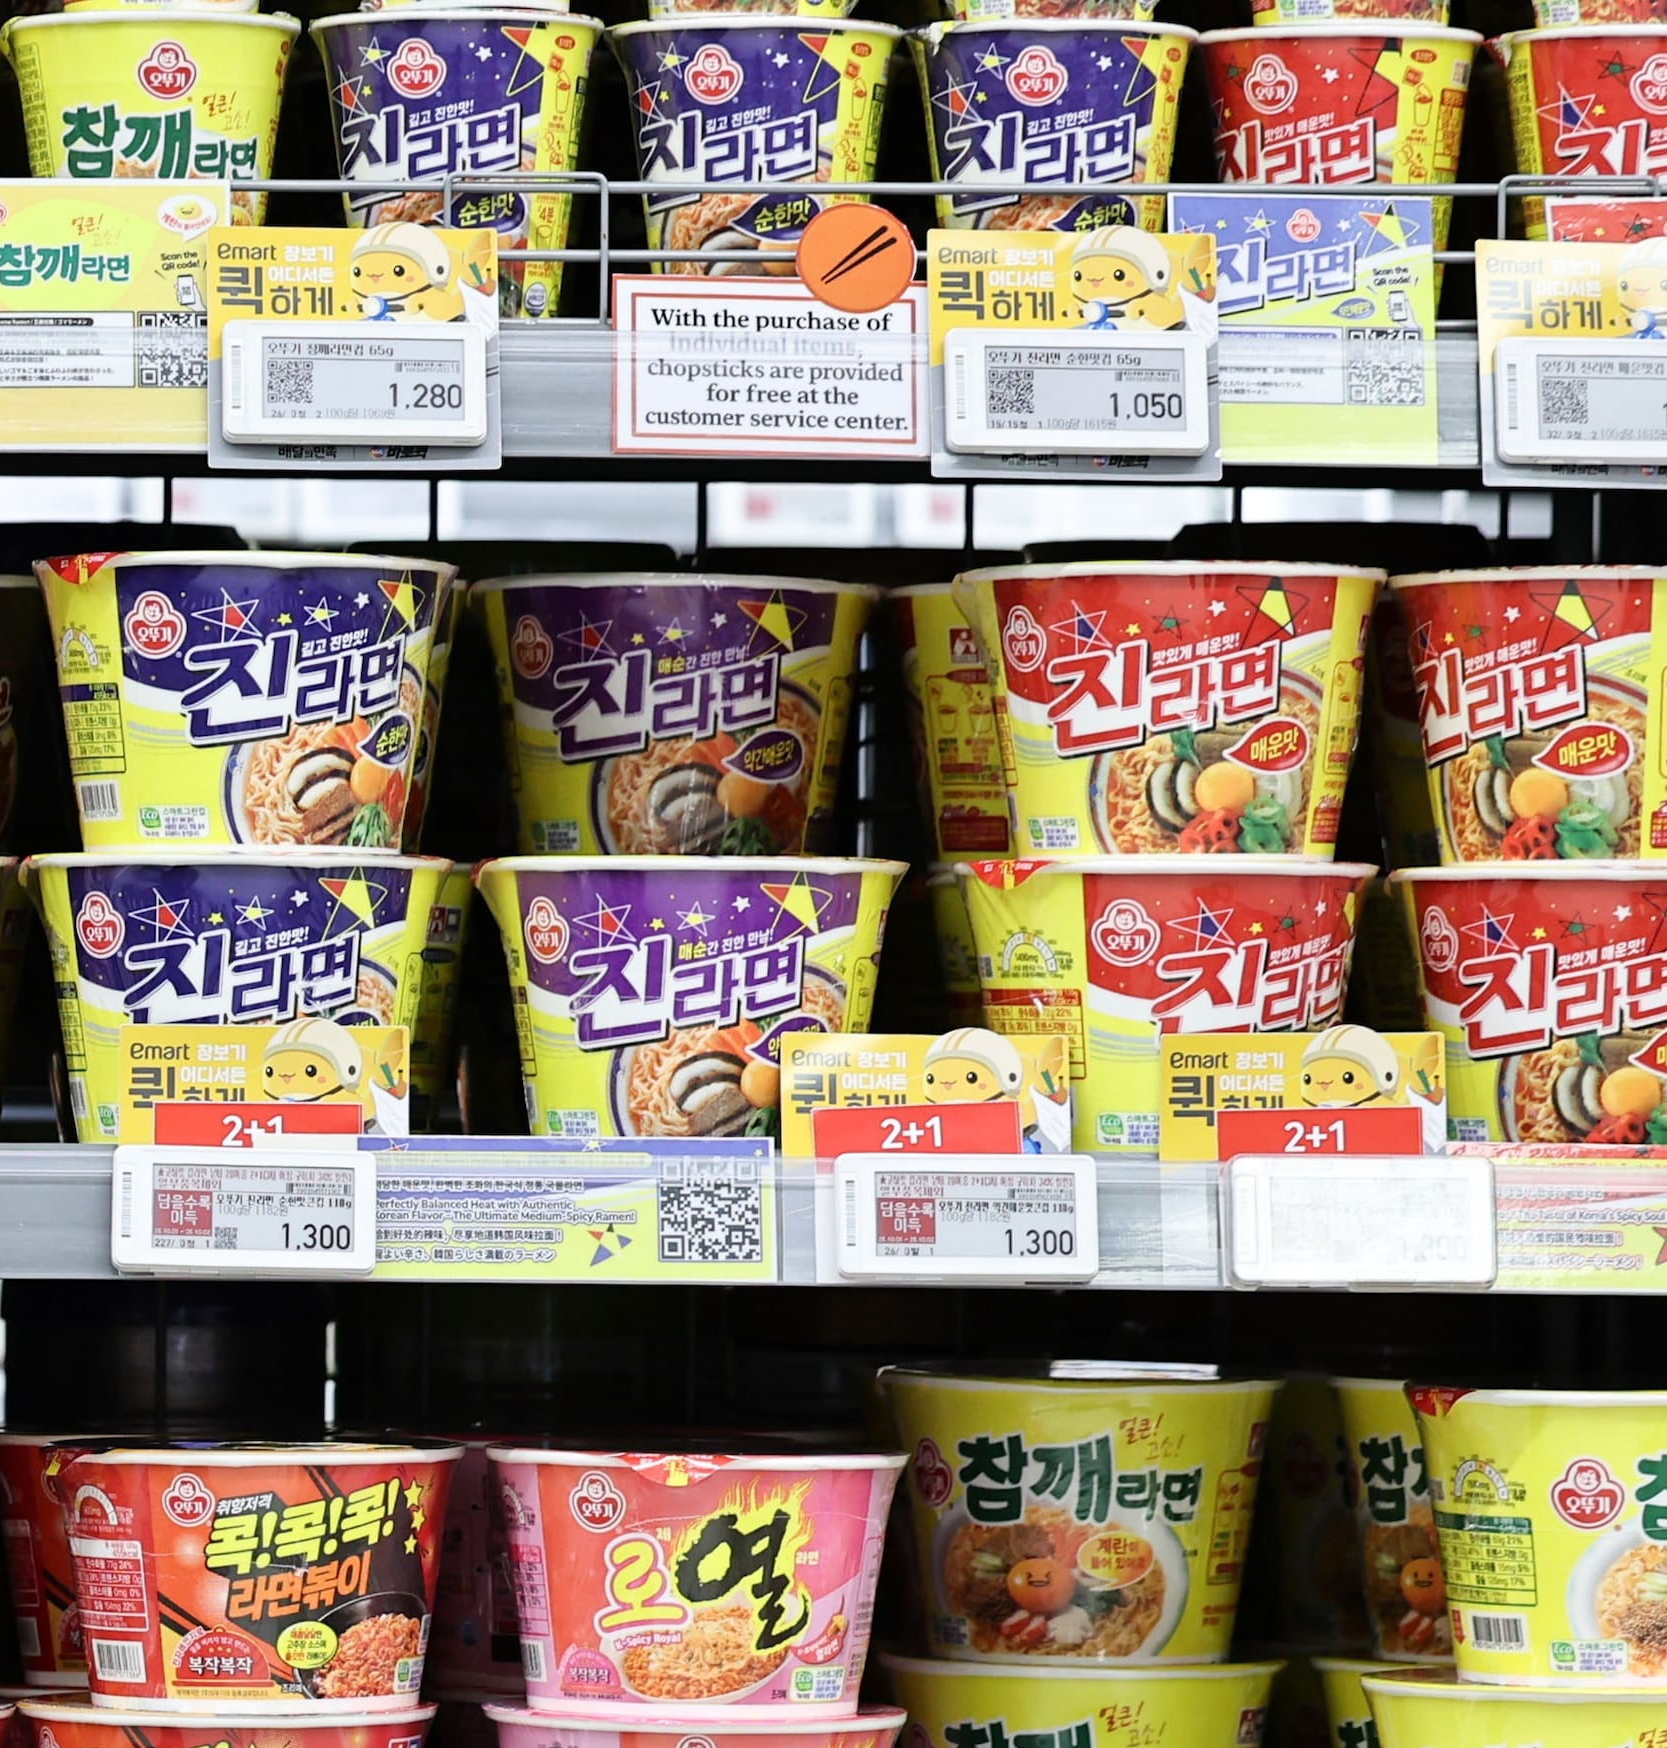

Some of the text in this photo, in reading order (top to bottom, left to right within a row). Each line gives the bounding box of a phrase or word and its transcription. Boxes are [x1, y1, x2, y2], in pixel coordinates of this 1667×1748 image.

[651, 308, 892, 333] With the purchase of
[669, 333, 787, 355] individual
[647, 358, 903, 384] chopsticks are provided
[387, 381, 463, 412] 1,280
[706, 383, 858, 405] for free at the
[1109, 390, 1183, 421] 1,050
[645, 410, 908, 431] customer service center.
[187, 630, 403, 740] 진라면
[1048, 643, 1280, 754] 진라면
[554, 652, 780, 752] 진라면
[1249, 732, 1300, 763] 매운맛
[1558, 730, 1619, 766] 매운맛
[573, 936, 800, 1042] 진라면
[881, 1116, 943, 1148] 2+1
[1284, 1121, 1345, 1152] 2+1
[422, 1199, 573, 1210] Balanced Heat with Authentic
[475, 1211, 518, 1221] Ultimate
[596, 1212, 635, 1222] Ramen!
[281, 1222, 351, 1251] 1,300
[1004, 1228, 1073, 1256] 1,300
[956, 1434, 1203, 1527] 참깨라면
[1564, 1493, 1615, 1519] 오뚜기
[205, 1480, 404, 1576] 콕!콕!콕!
[228, 1556, 372, 1621] 라면볶이
[190, 1654, 254, 1677] 복작복작
